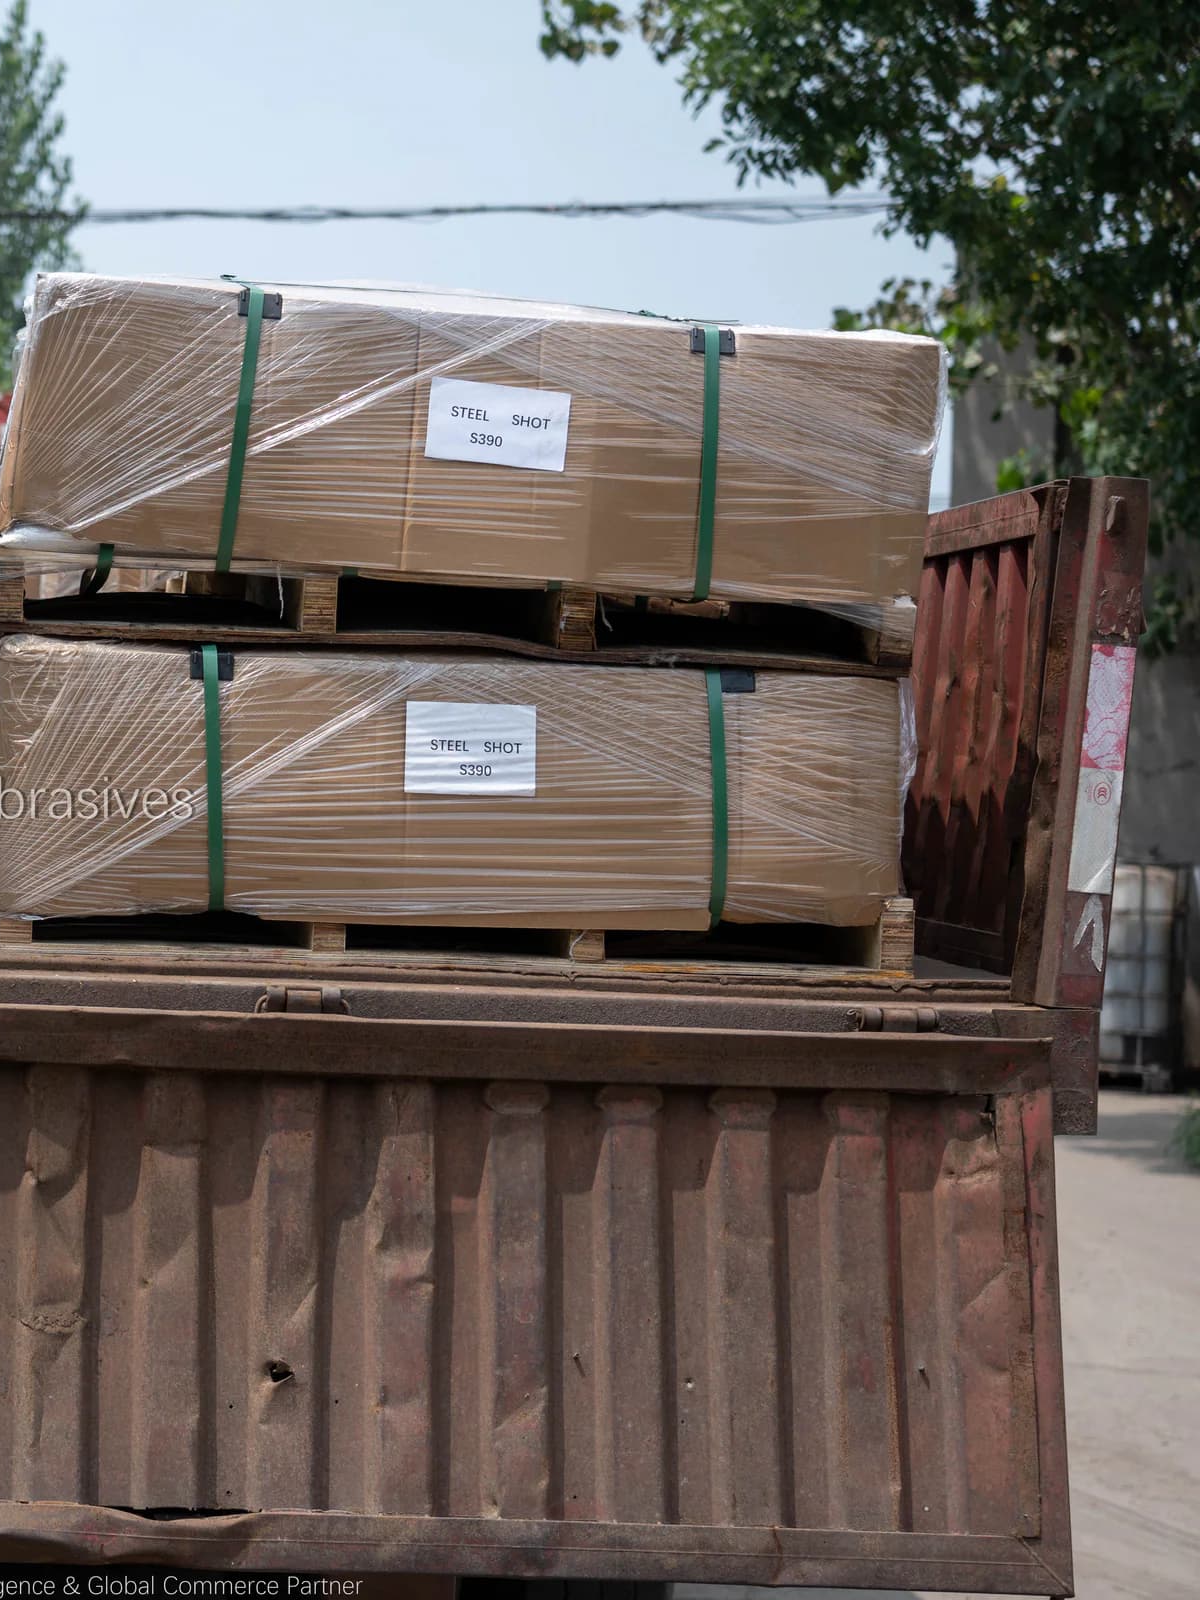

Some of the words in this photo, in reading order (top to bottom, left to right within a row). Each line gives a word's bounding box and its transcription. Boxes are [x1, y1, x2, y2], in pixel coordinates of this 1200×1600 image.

[451, 405, 489, 422] STEEL
[511, 414, 551, 430] SHOT
[470, 432, 503, 447] S390
[430, 739, 469, 752] STEEL
[483, 741, 522, 754] SHOT
[459, 764, 492, 776] S390
